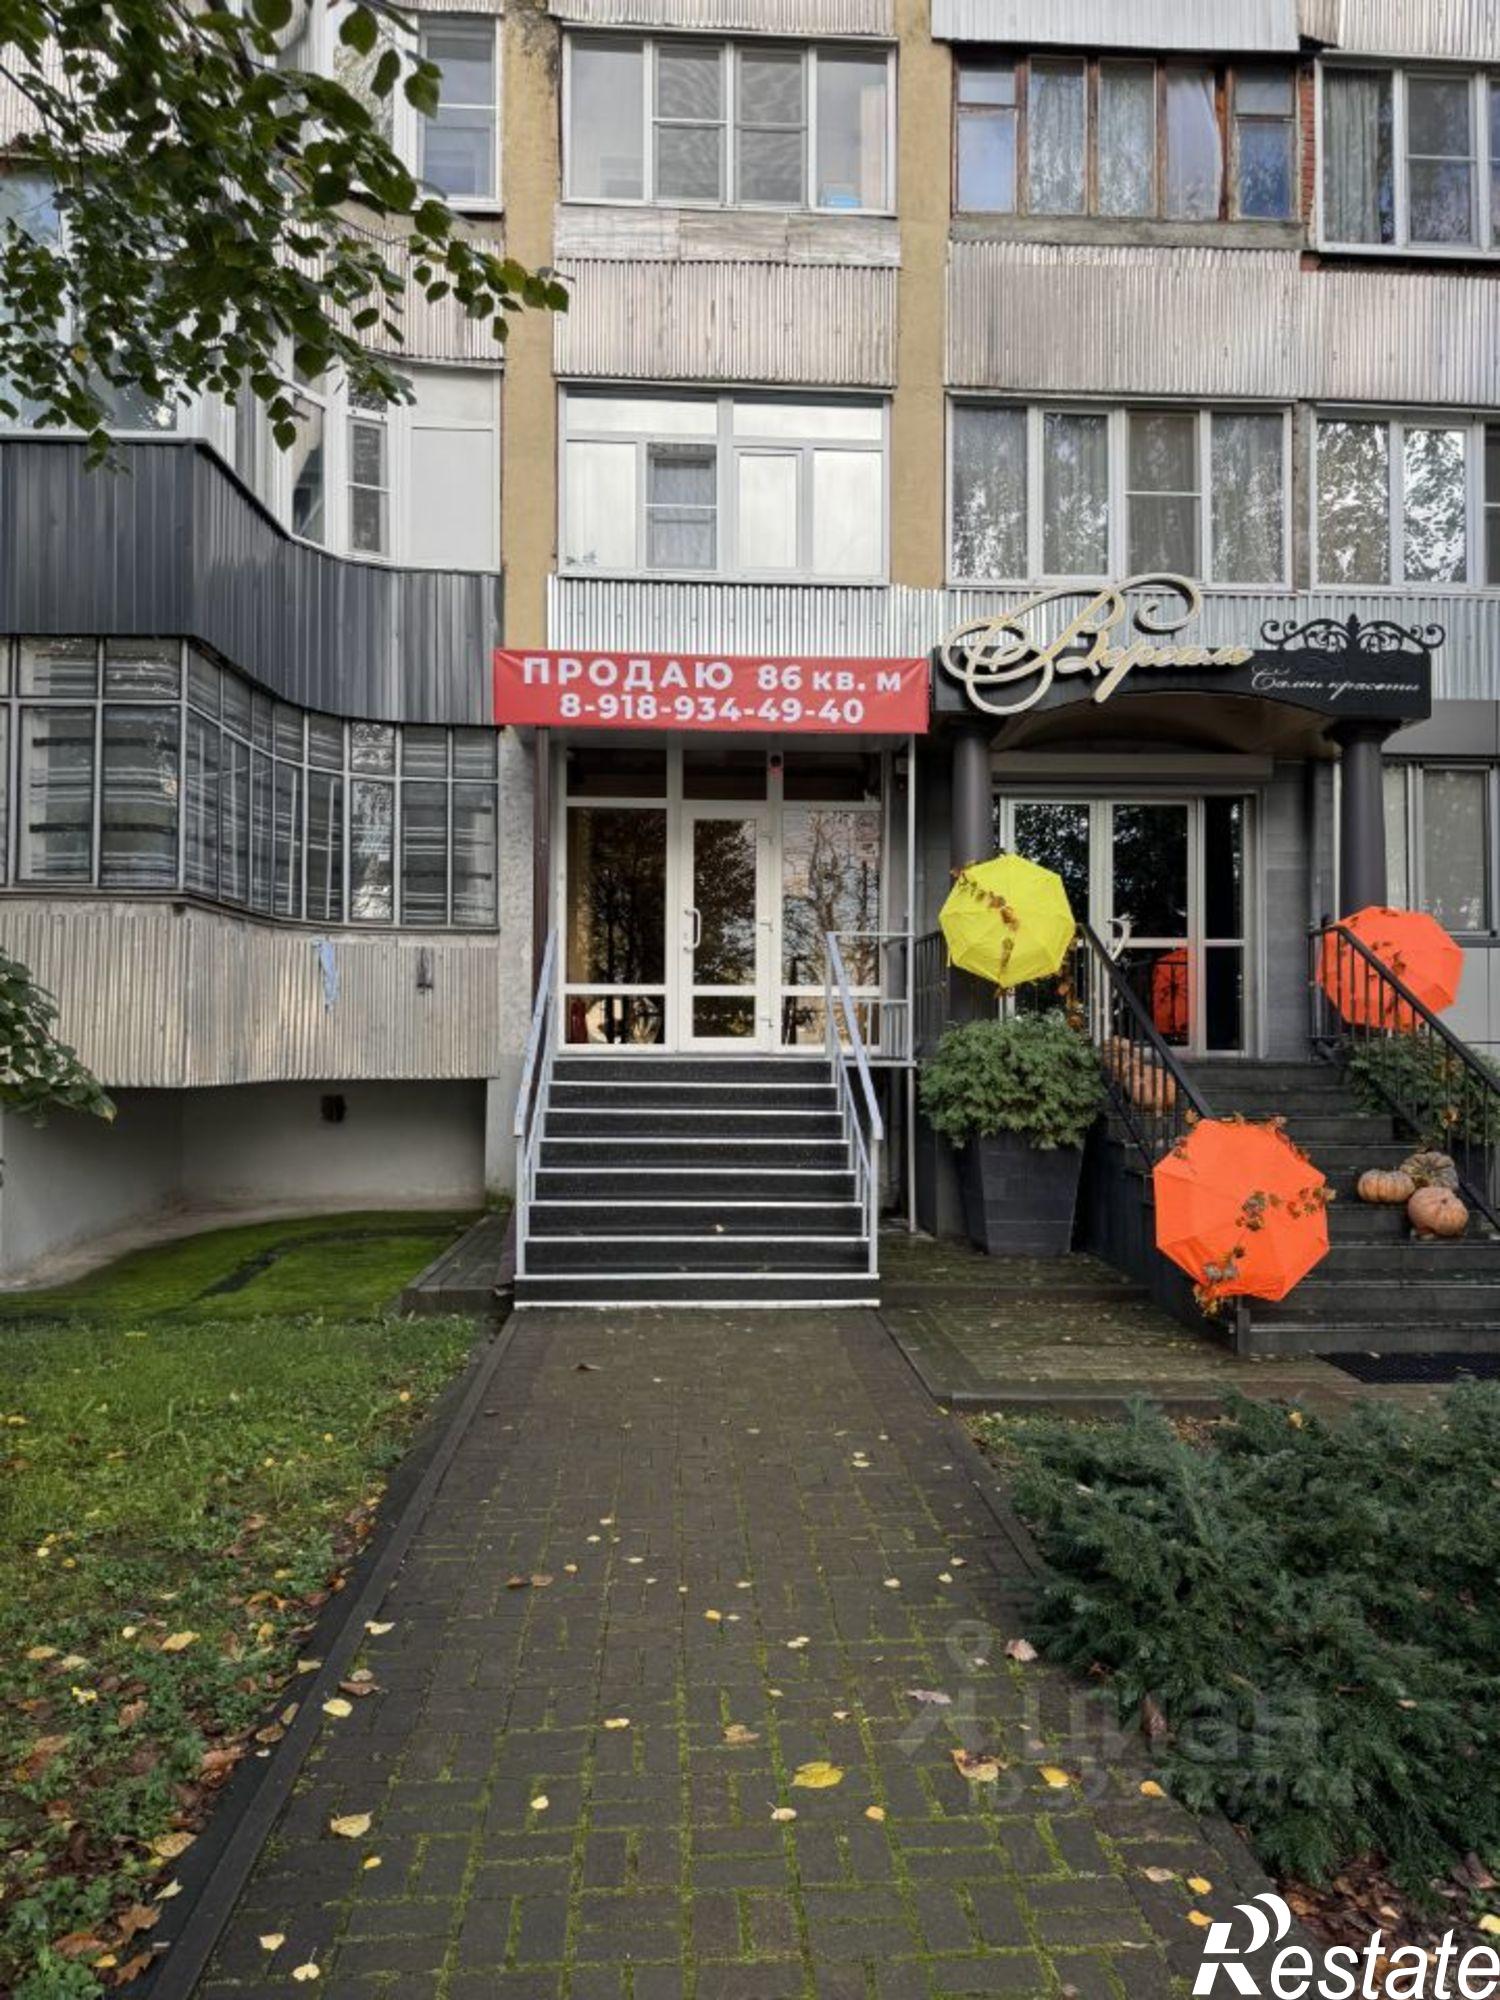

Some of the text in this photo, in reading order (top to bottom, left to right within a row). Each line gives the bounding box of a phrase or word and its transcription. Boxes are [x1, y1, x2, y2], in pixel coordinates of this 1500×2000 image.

[522, 657, 902, 692] ПРОДАЮ 86 кв. м
[559, 693, 865, 725] 8-918-934-49-40
